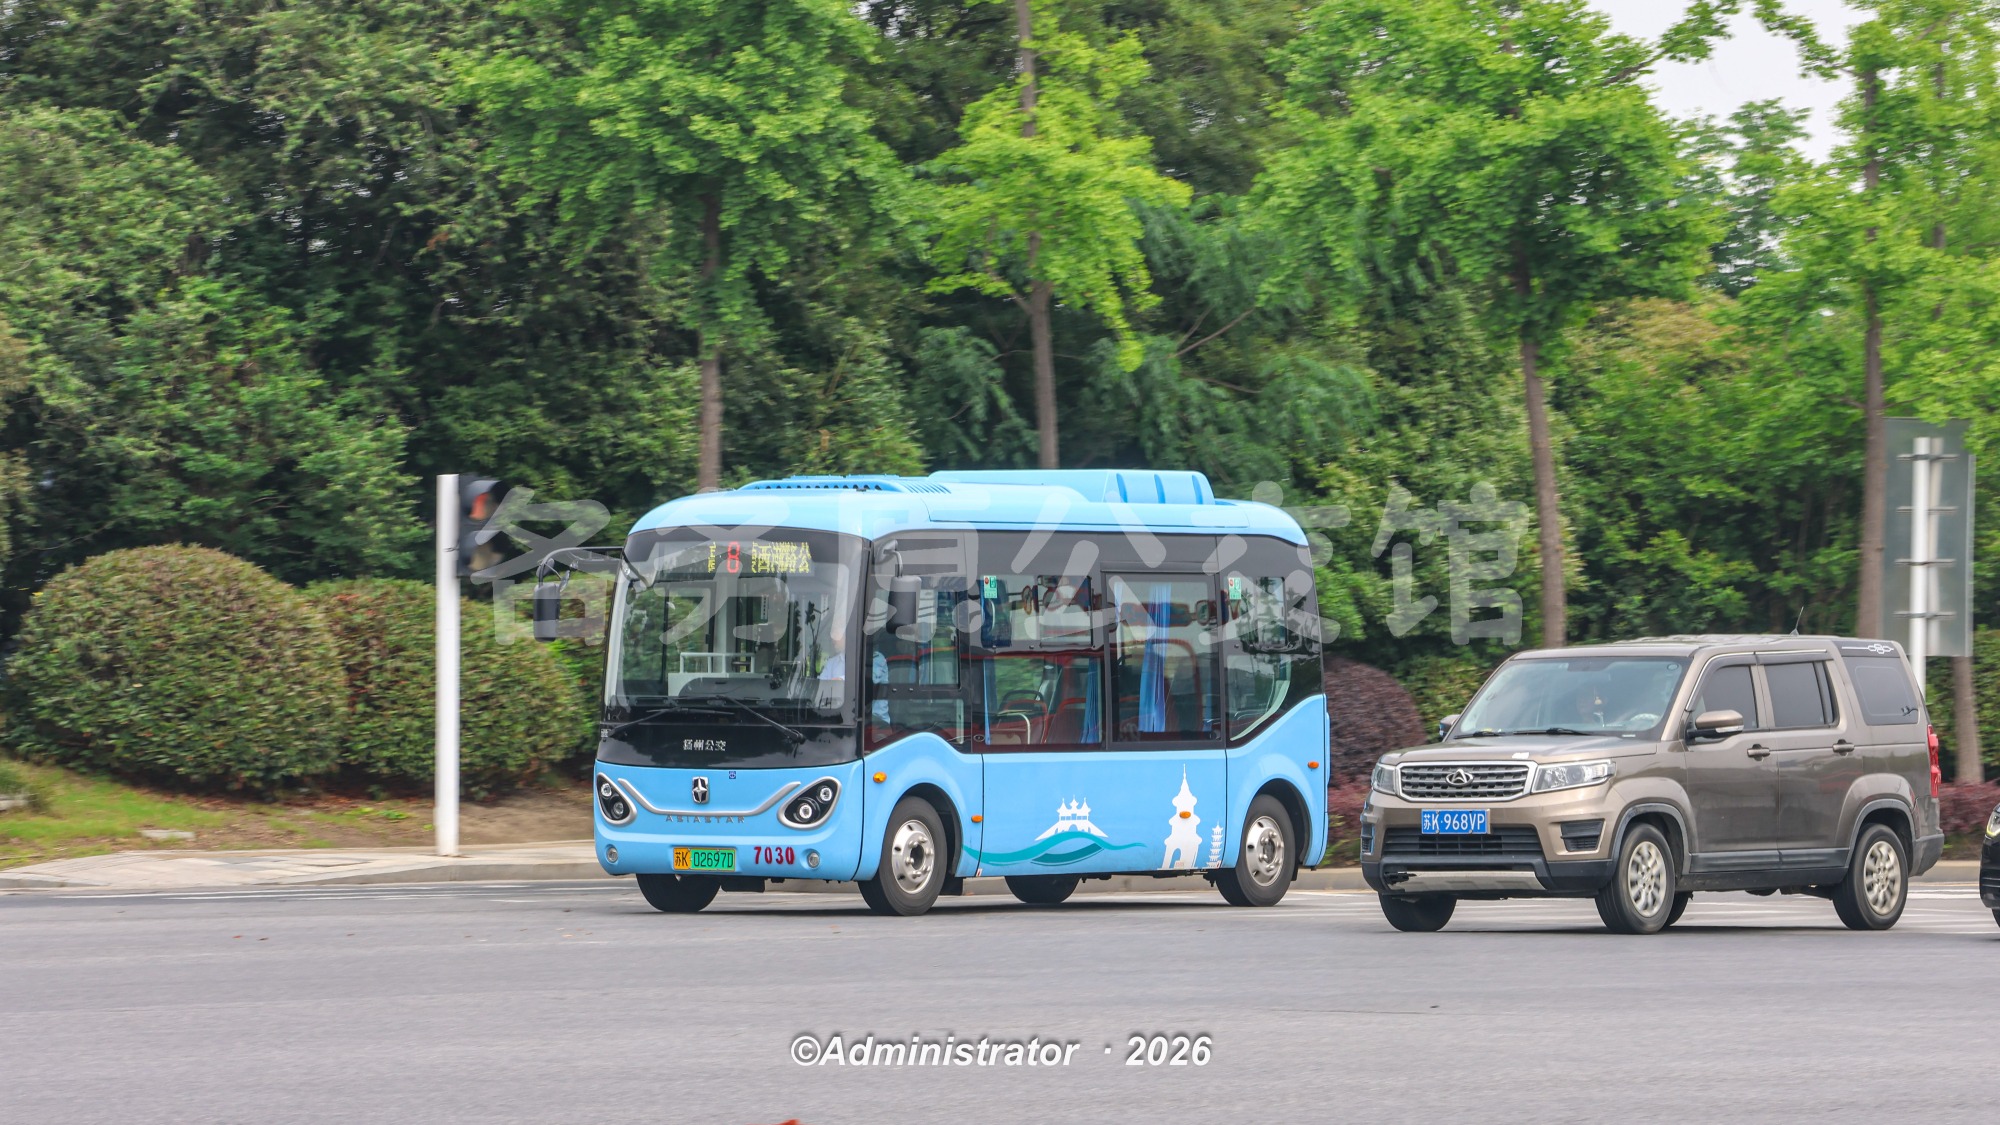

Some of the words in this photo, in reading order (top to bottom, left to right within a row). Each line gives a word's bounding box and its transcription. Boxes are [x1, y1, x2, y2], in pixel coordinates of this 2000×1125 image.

[726, 541, 741, 573] 8
[683, 739, 727, 751] 扬州公交
[665, 815, 746, 823] ASIASTAR
[754, 846, 795, 865] 7030
